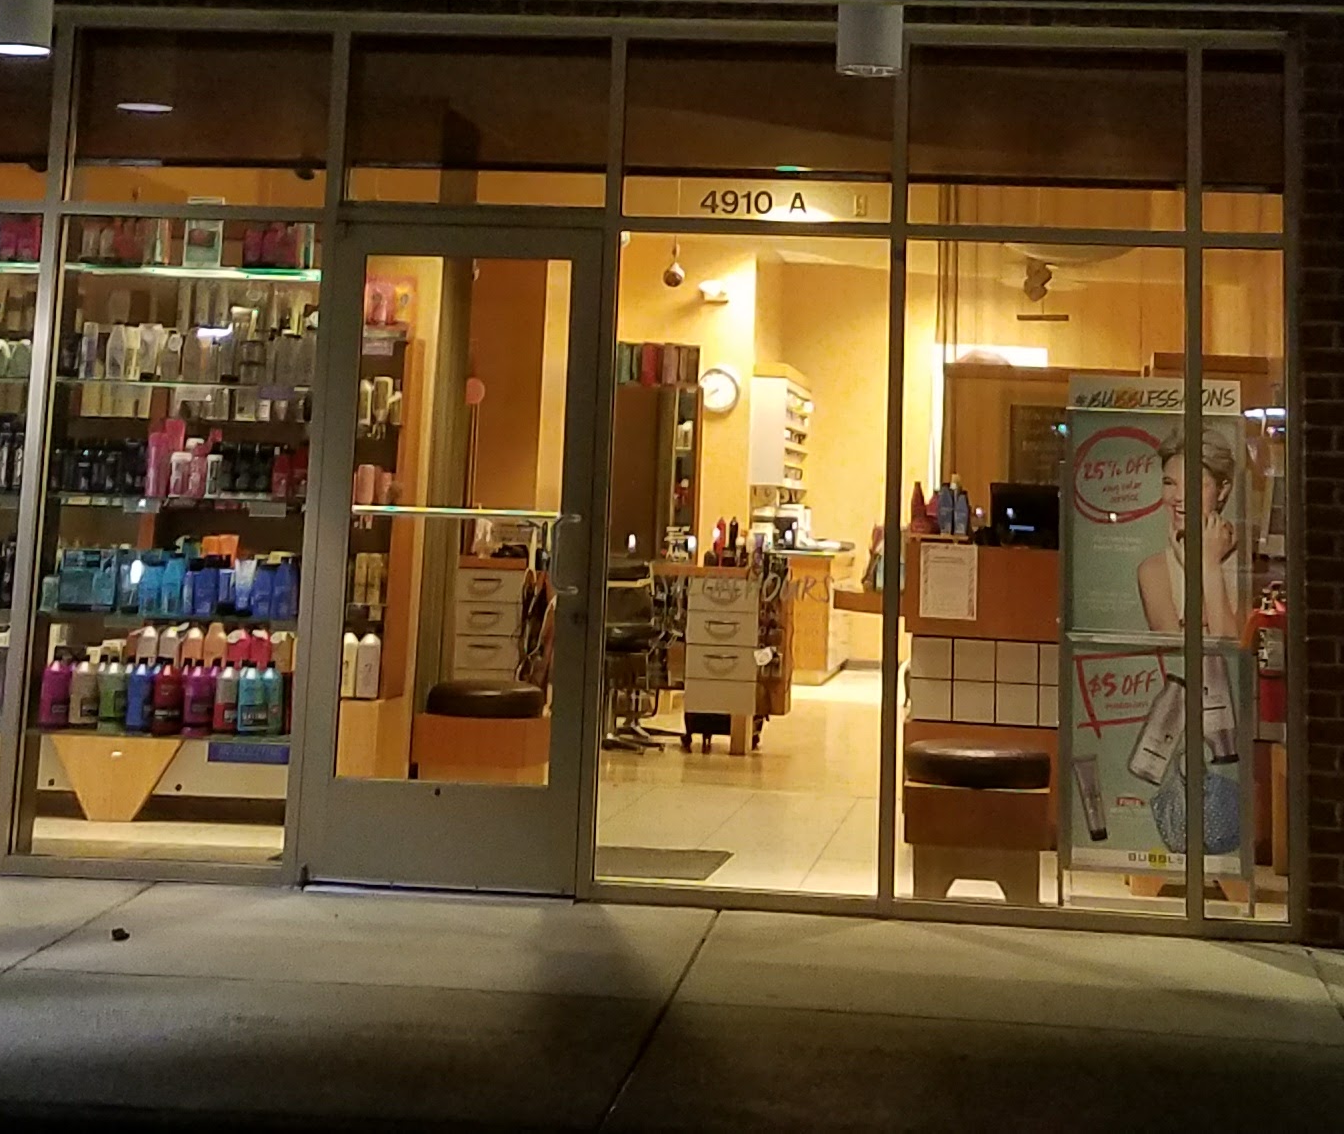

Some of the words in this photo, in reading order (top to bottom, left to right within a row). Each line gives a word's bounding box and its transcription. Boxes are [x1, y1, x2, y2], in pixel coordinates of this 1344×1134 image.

[700, 190, 773, 214] 4910
[790, 192, 806, 213] A
[1126, 454, 1155, 475] OFF
[1088, 672, 1118, 698] $5
[1121, 668, 1158, 695] OFF
